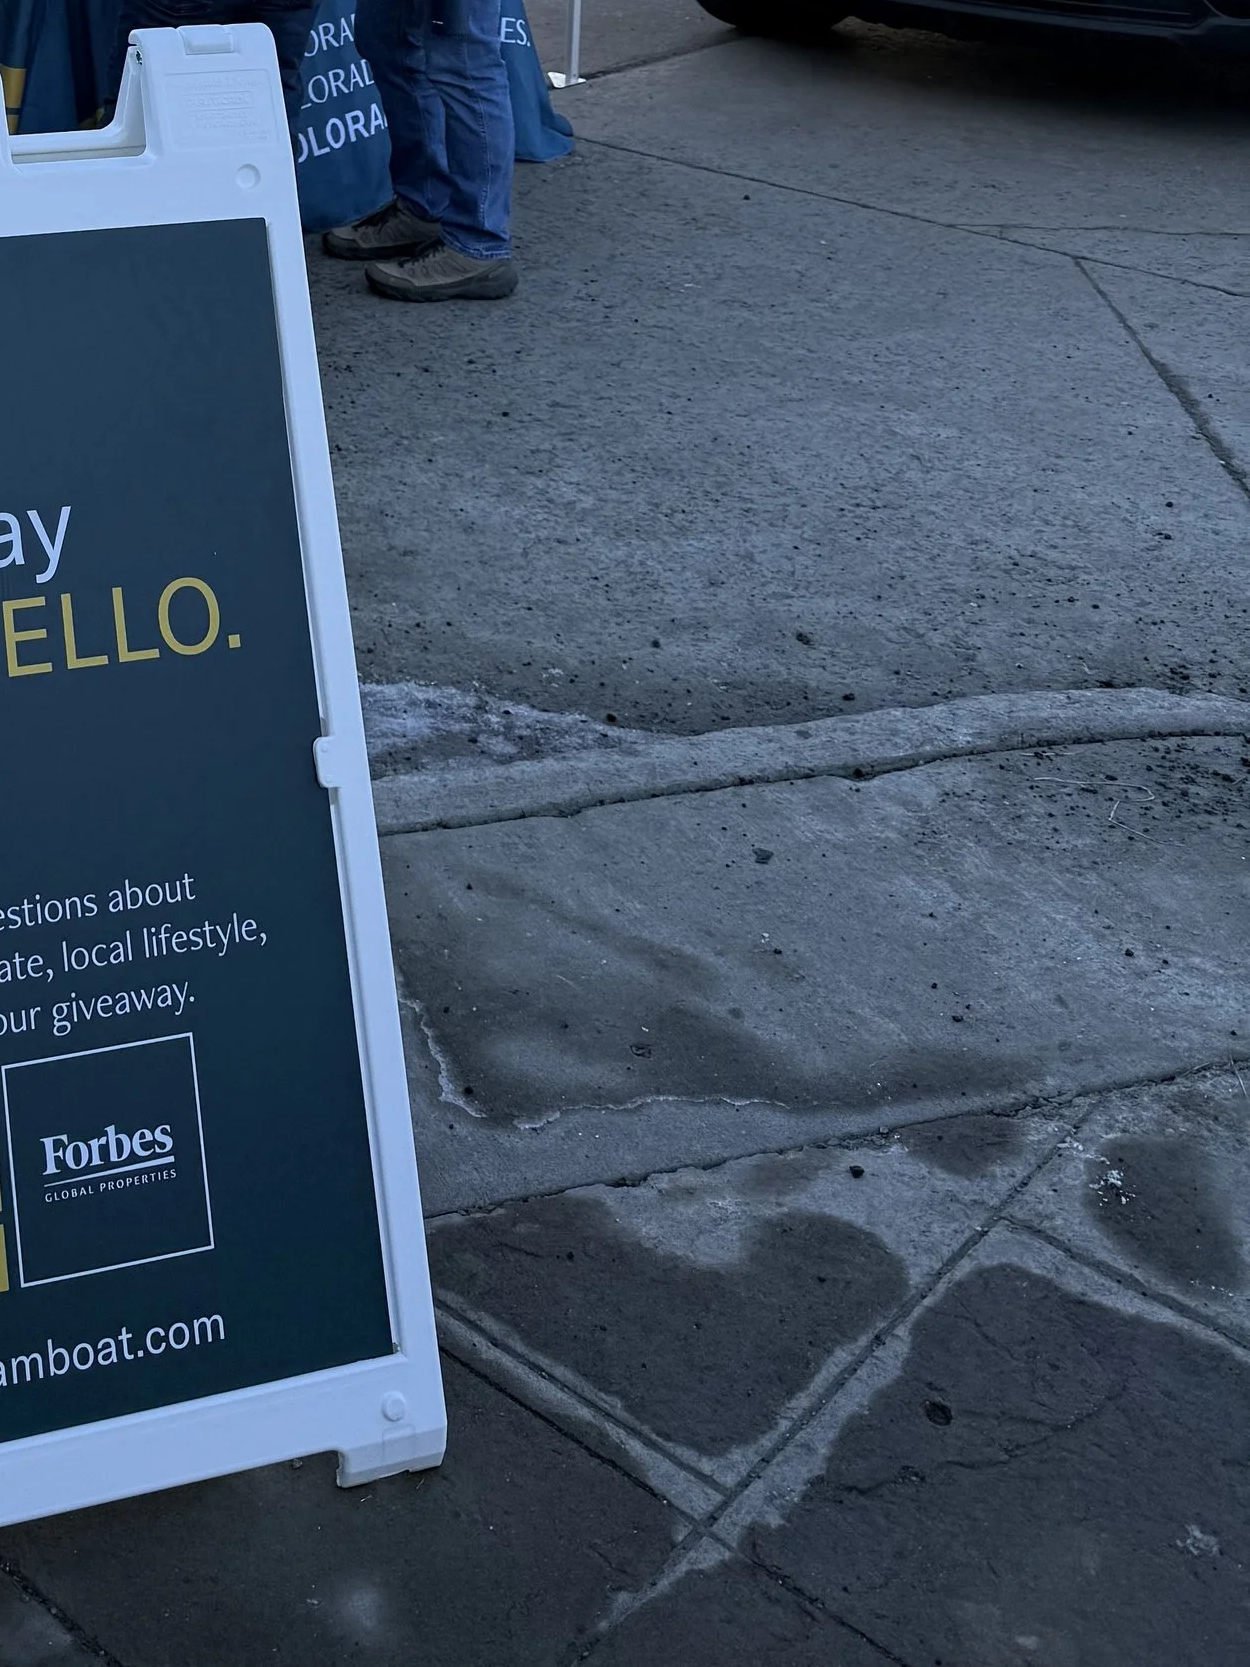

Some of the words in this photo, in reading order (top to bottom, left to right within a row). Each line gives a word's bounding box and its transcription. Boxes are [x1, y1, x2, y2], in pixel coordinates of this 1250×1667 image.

[108, 873, 196, 913] about
[62, 939, 133, 973] local
[143, 912, 267, 958] lifestyle,
[52, 981, 196, 1036] giveaway.
[39, 1123, 173, 1176] Forbes
[44, 1184, 94, 1203] GLOBAL
[99, 1168, 178, 1193] PROPERTIES
